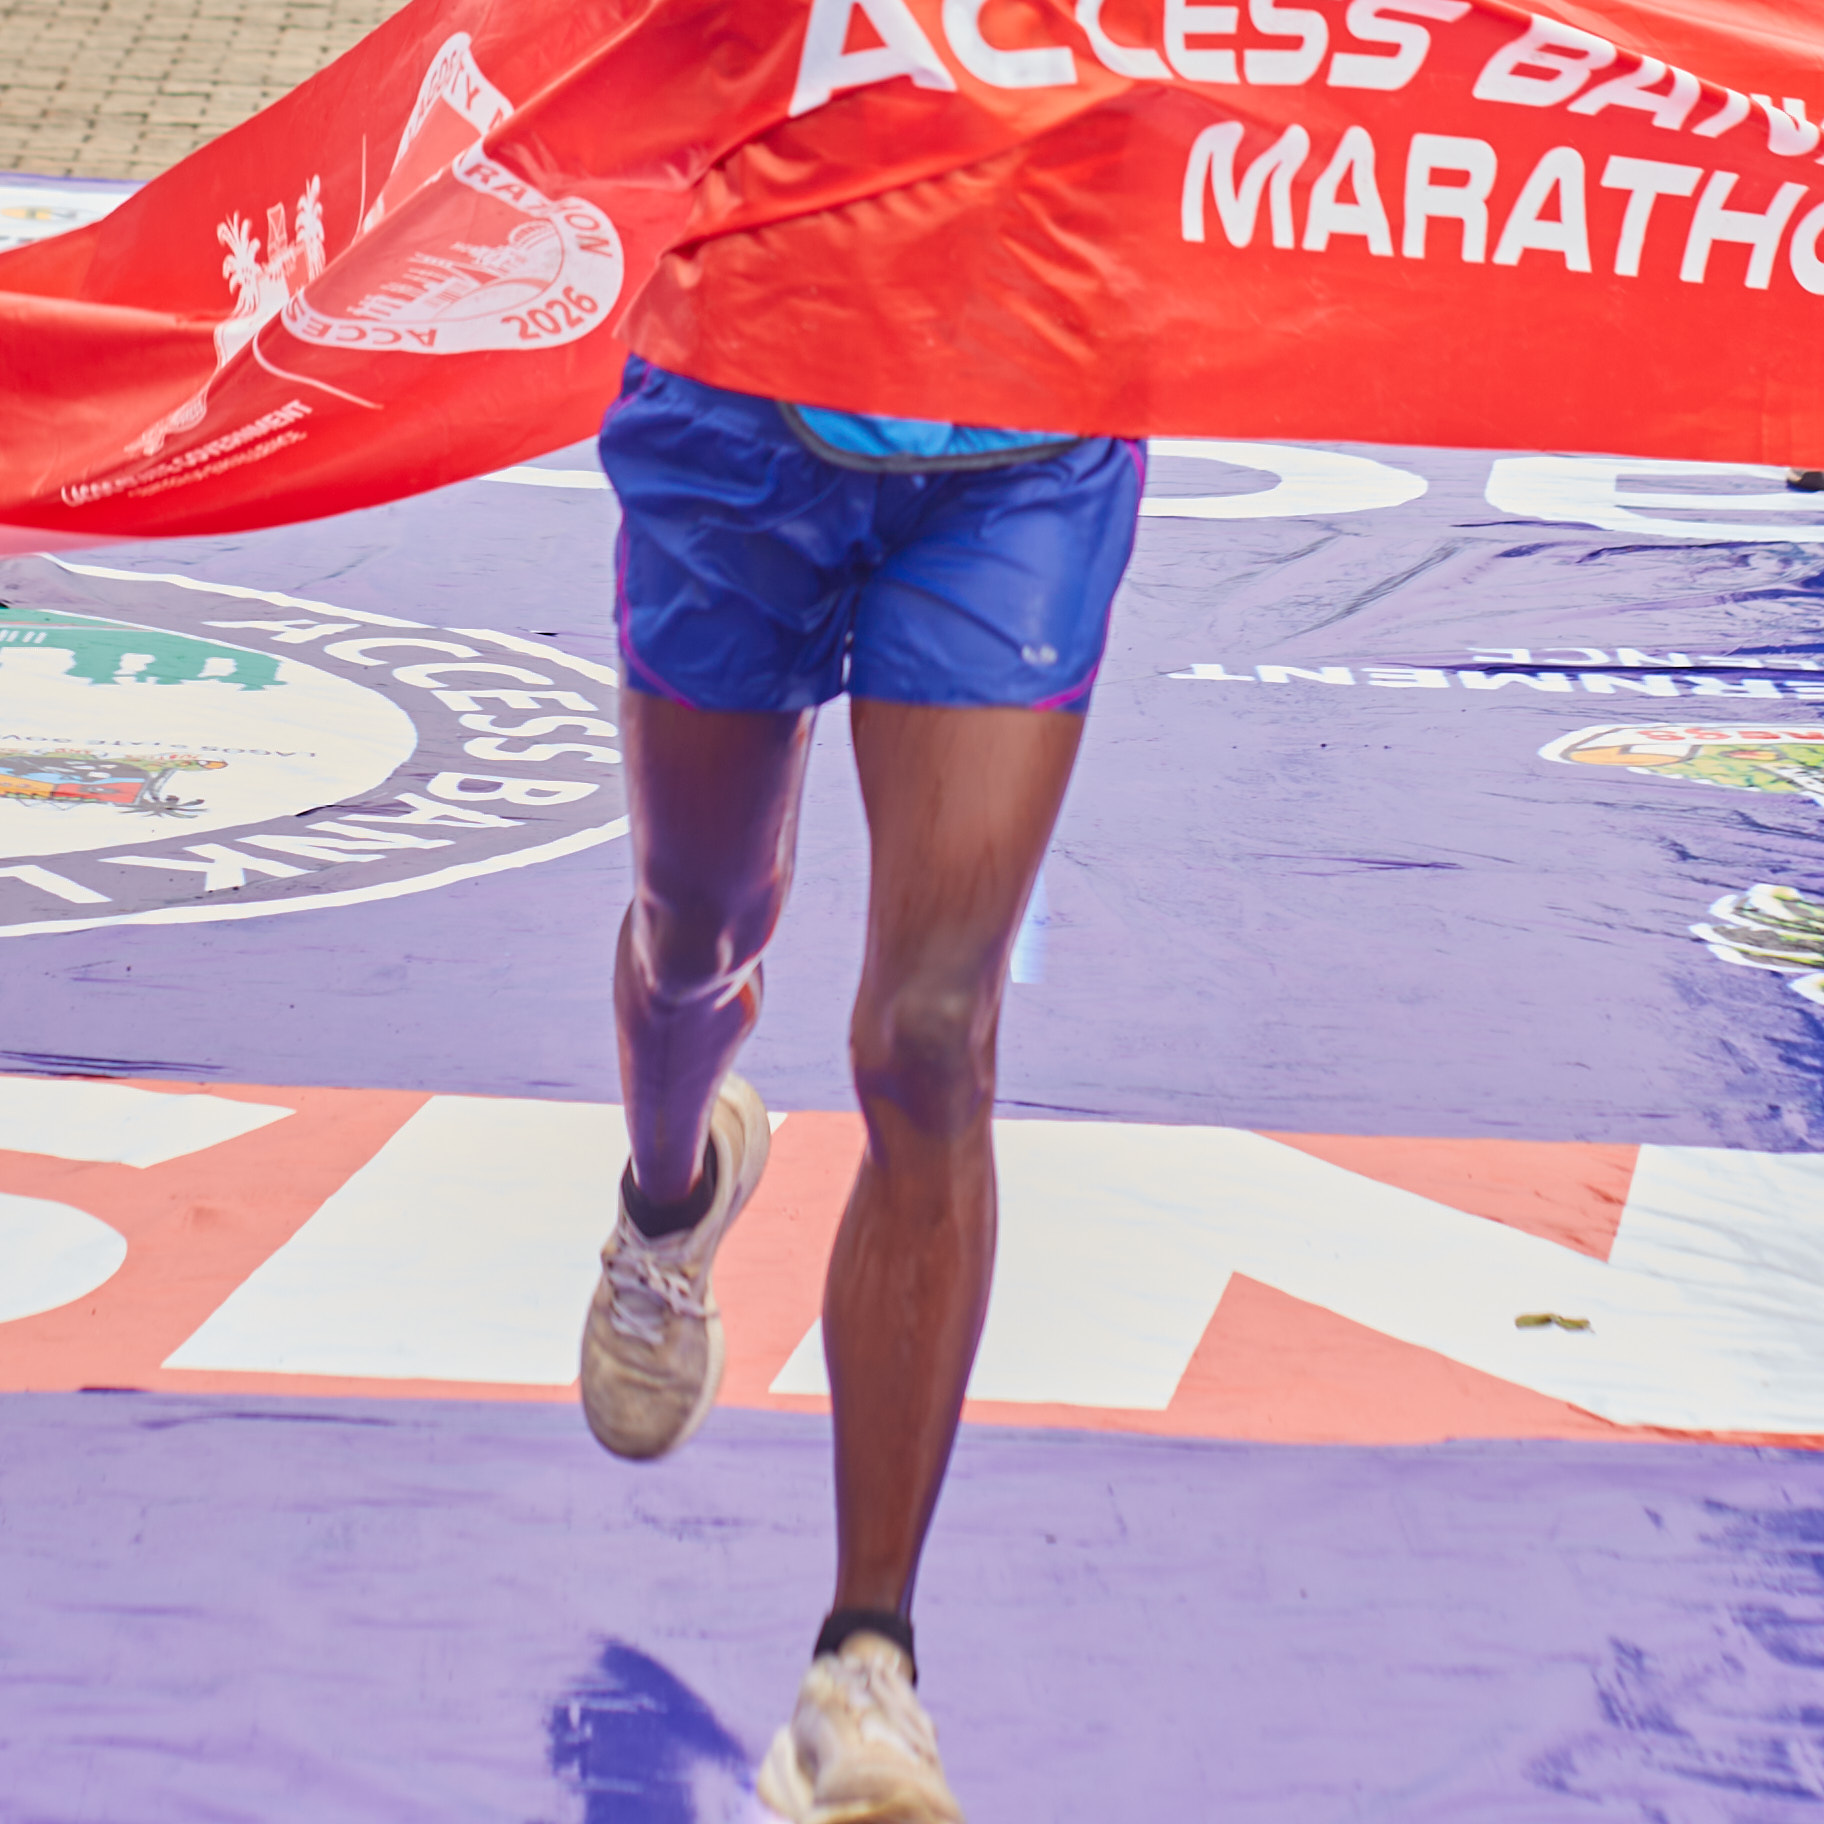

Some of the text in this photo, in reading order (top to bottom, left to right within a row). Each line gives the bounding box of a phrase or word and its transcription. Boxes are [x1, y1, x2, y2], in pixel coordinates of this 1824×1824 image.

[500, 285, 600, 343] 2026
[201, 618, 623, 765] ACCESS
[199, 745, 317, 759] LAGOS
[101, 771, 600, 892] BANK
